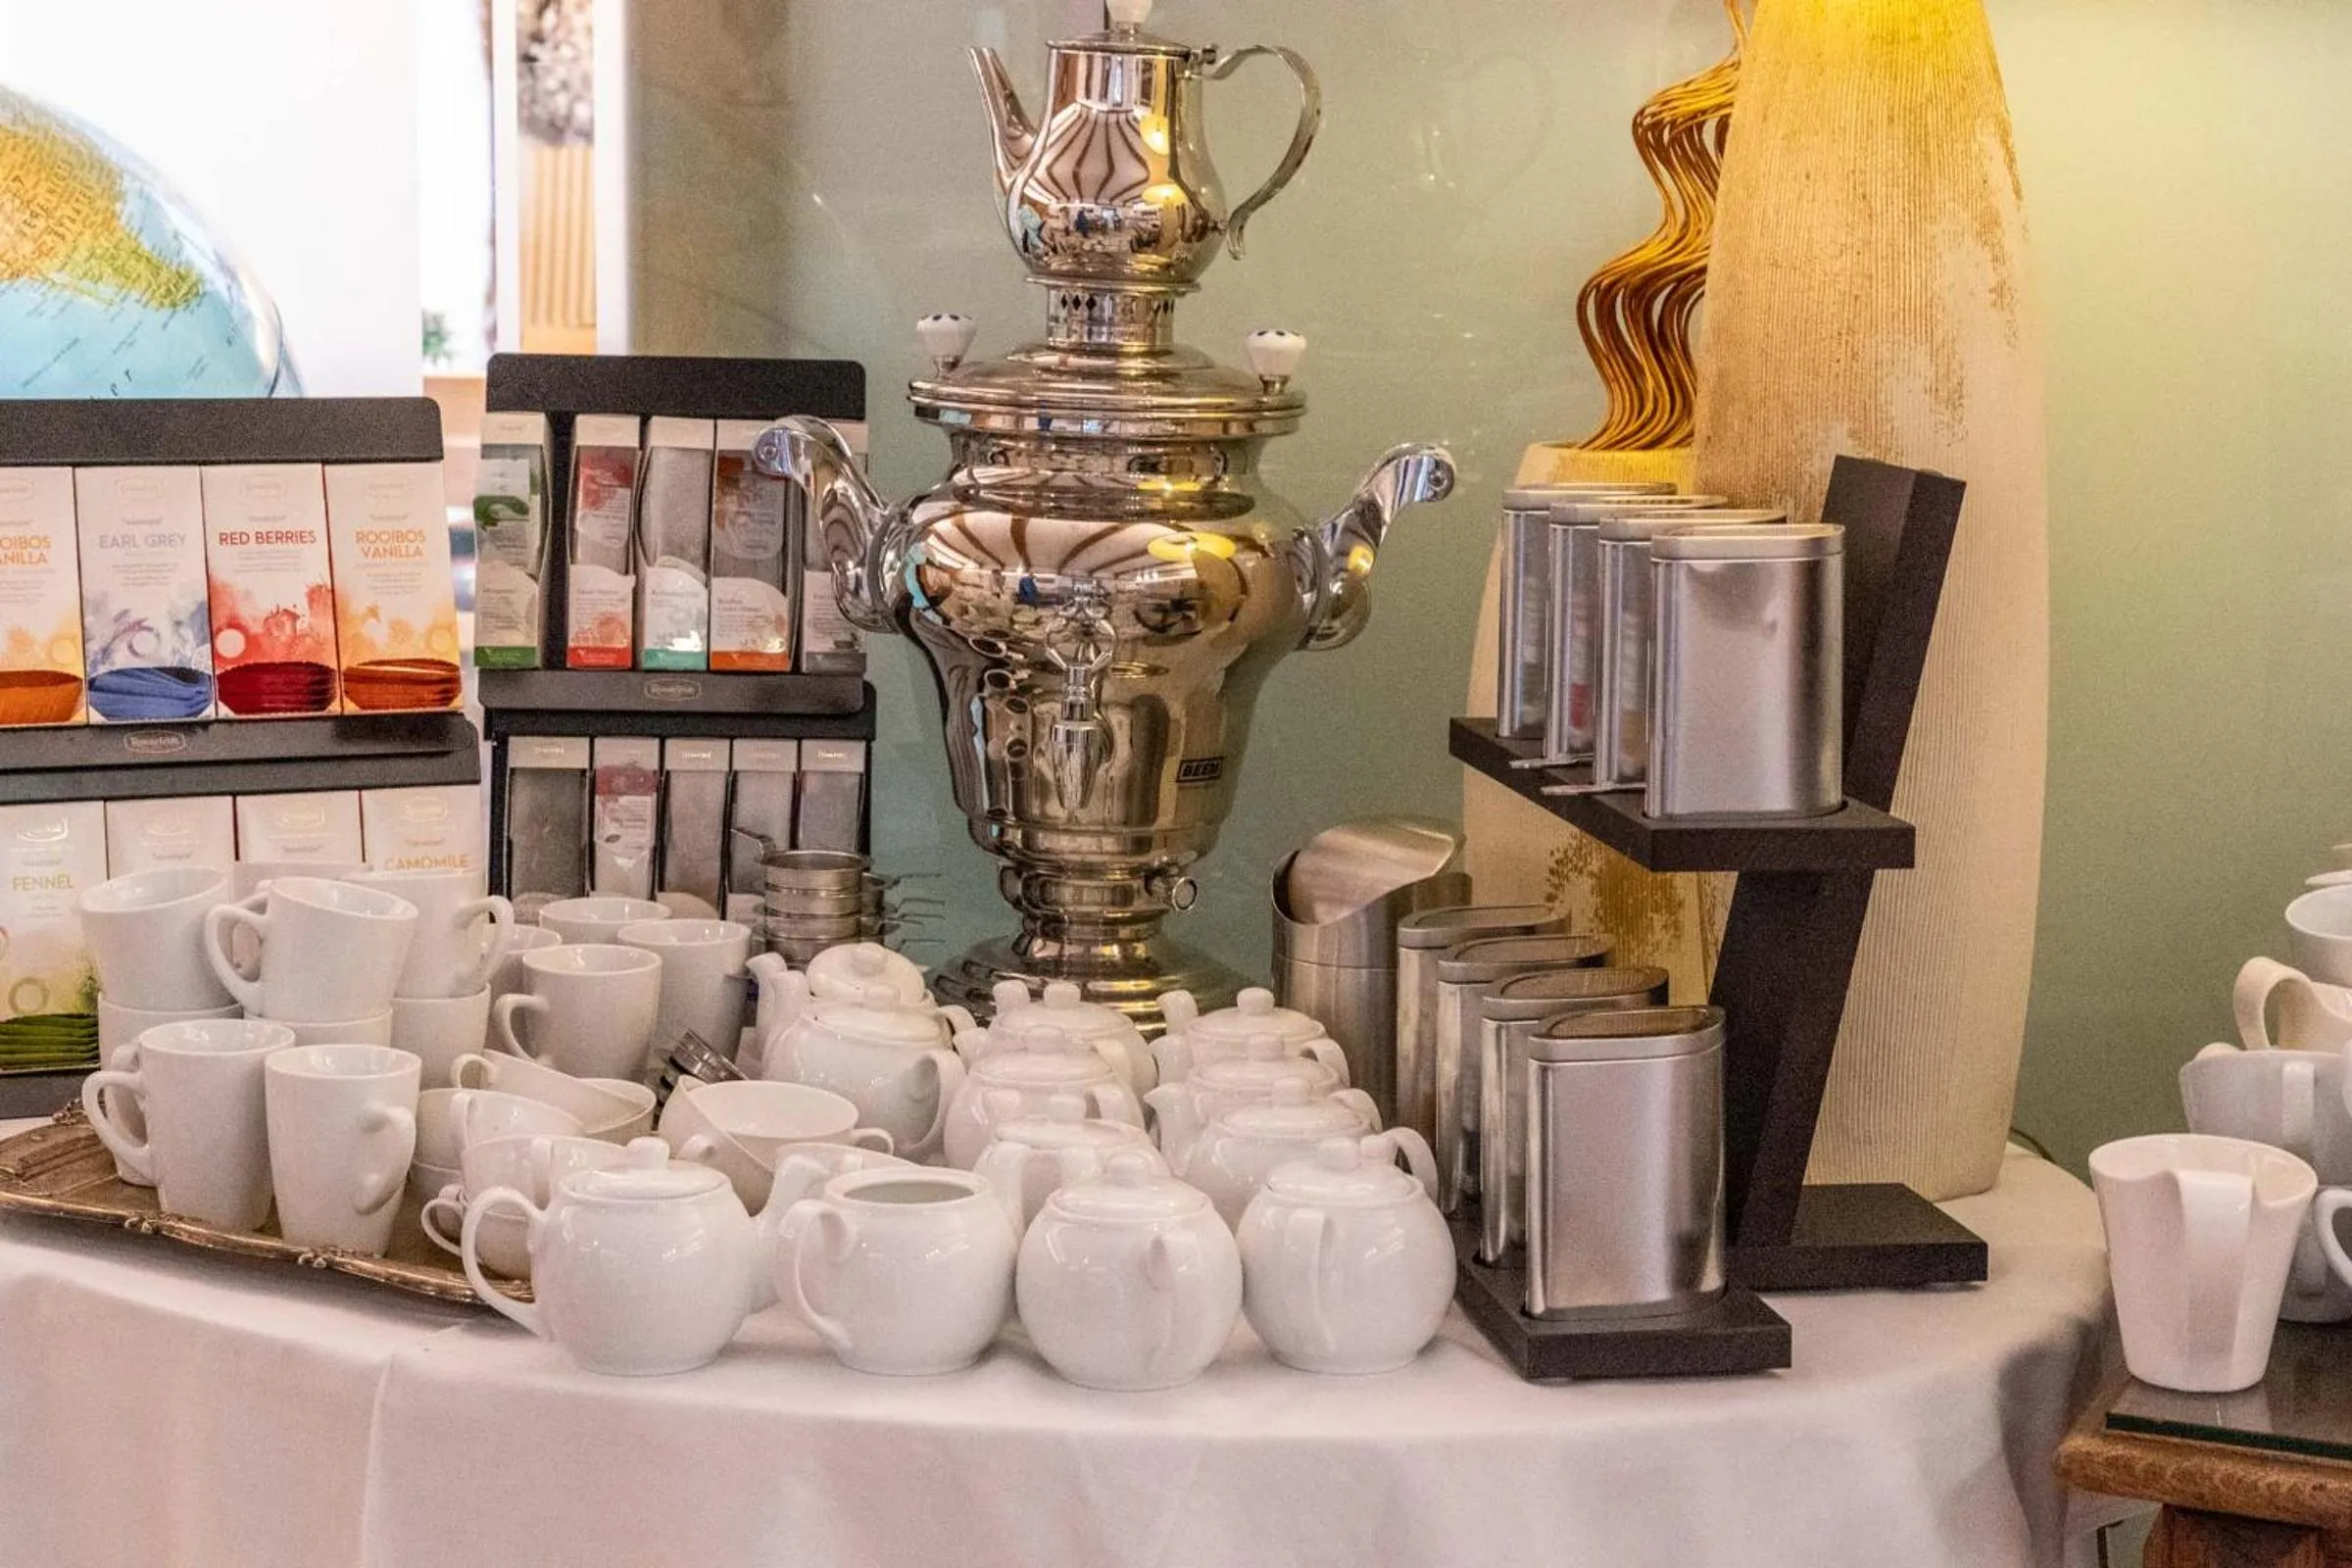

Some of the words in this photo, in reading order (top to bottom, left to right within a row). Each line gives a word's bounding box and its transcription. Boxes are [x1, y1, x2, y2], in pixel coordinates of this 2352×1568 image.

[99, 535, 140, 549] EARL
[144, 532, 186, 548] GREY
[219, 531, 250, 546] RED
[255, 529, 317, 545] BERRIES
[356, 529, 426, 544] ROOIBOS
[361, 545, 423, 559] VANILLA
[384, 854, 468, 870] CAMOMILE
[13, 873, 74, 891] FENNEL
